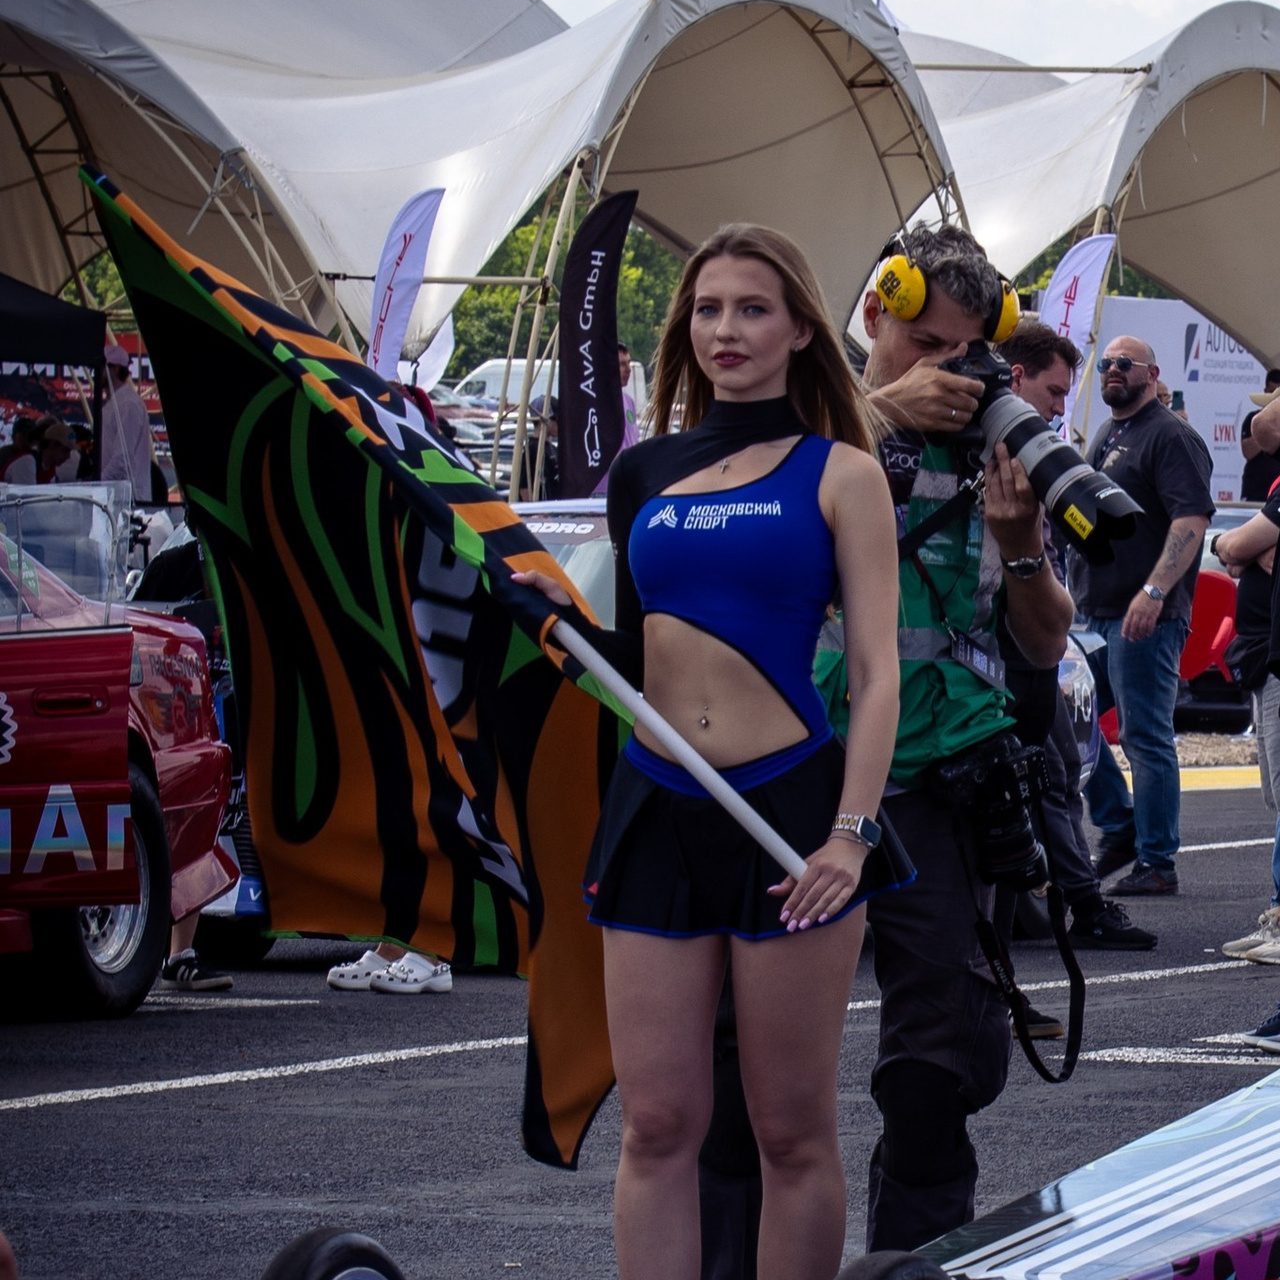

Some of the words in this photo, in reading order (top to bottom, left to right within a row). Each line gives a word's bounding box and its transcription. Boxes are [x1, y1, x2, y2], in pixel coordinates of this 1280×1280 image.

[579, 250, 606, 331] GmbH
[688, 499, 782, 517] МОСКОВСКИЙ
[683, 515, 730, 530] СПОРТ
